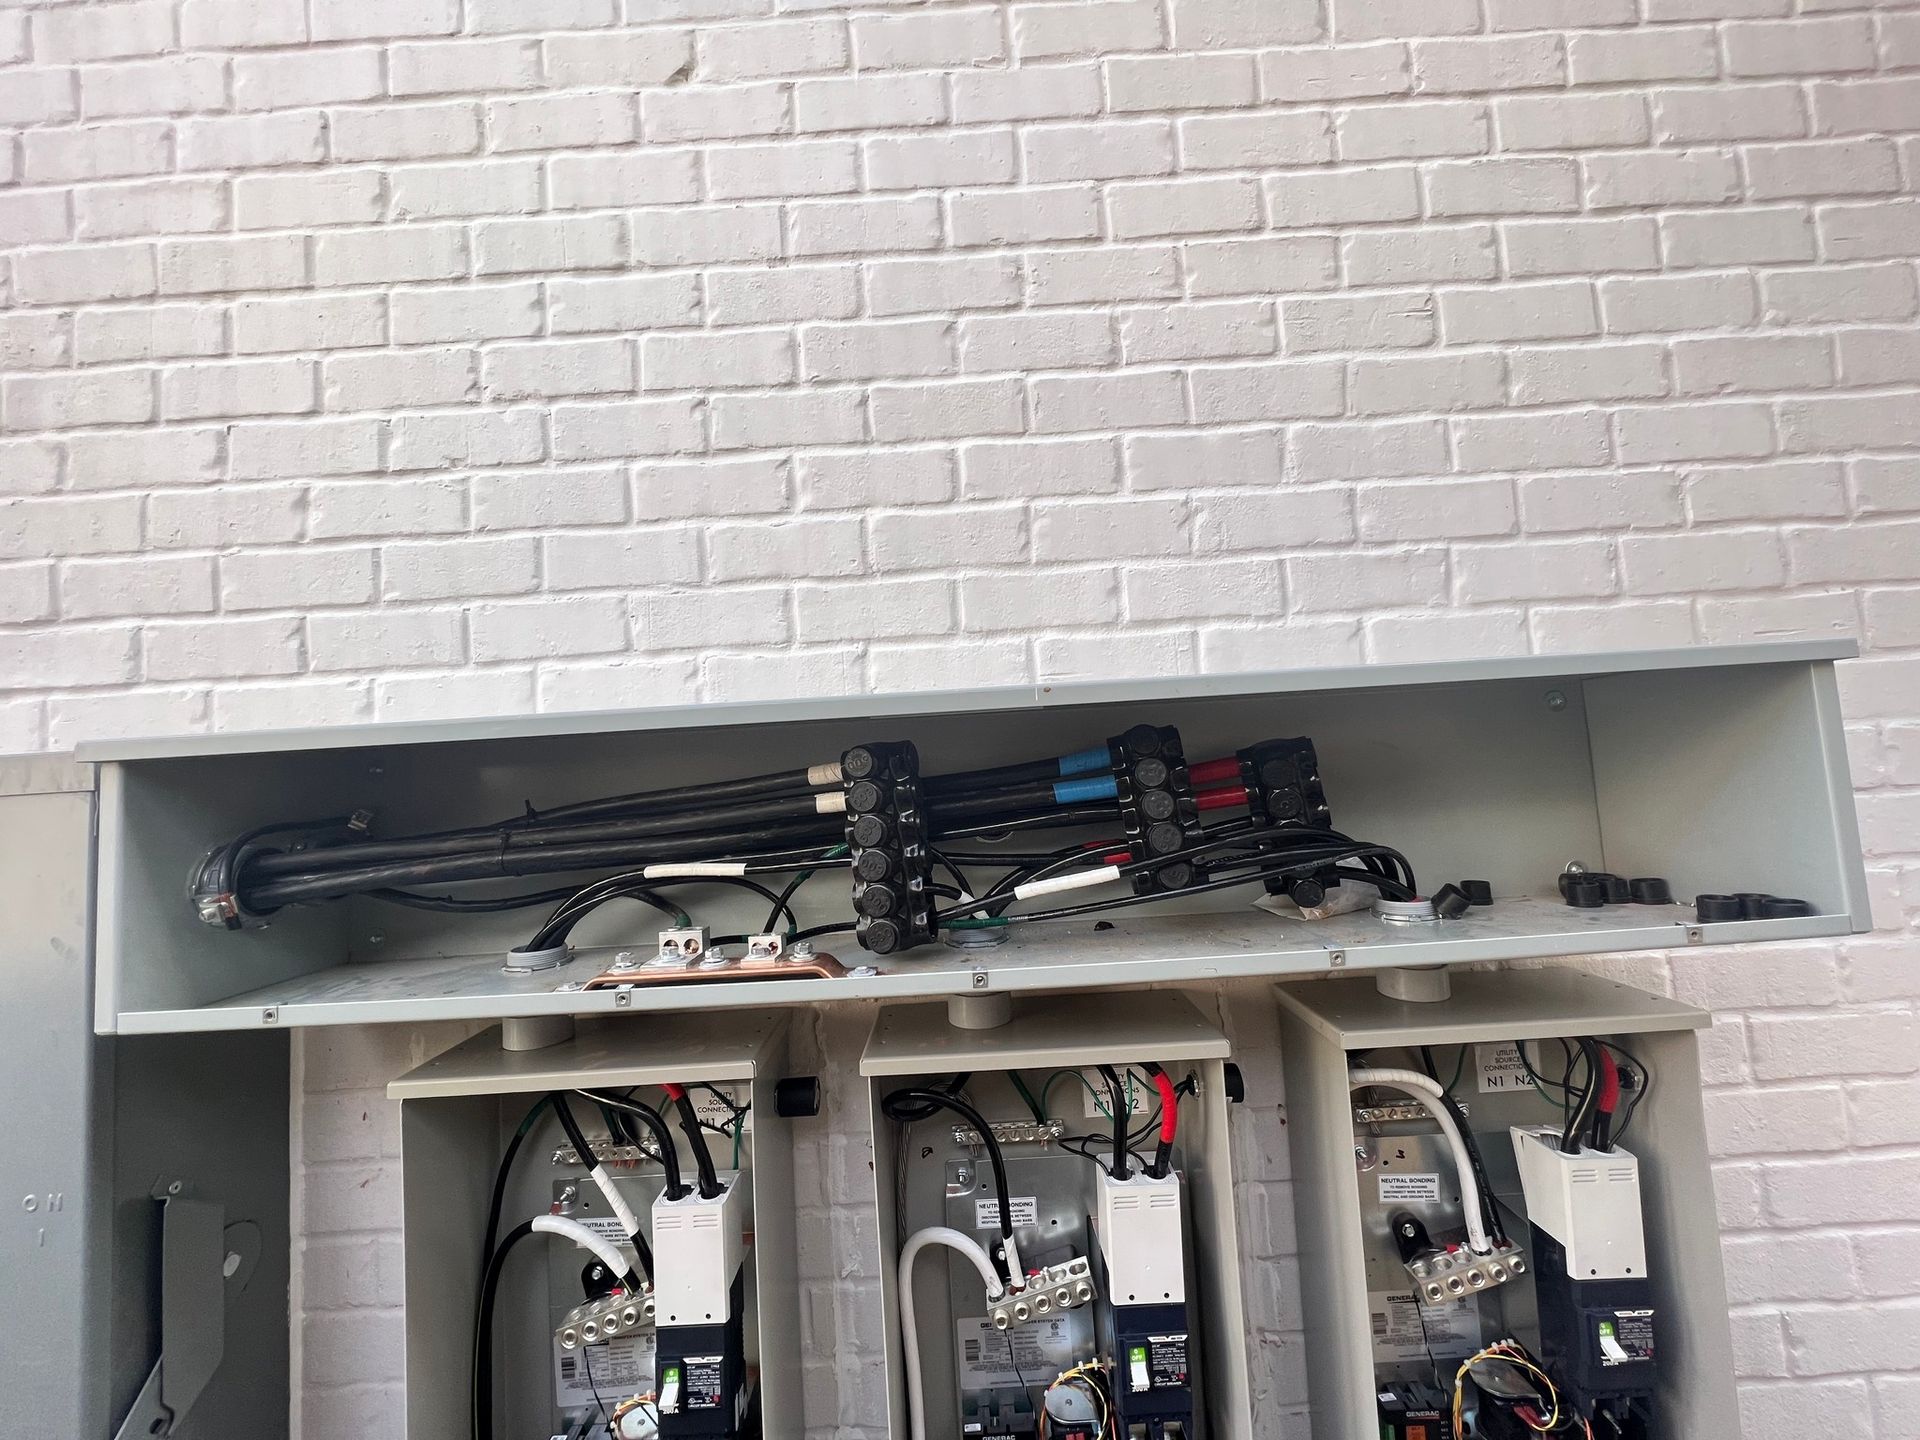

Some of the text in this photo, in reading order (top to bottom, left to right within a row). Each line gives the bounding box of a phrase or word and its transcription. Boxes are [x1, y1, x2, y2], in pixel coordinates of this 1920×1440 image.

[1484, 1063, 1524, 1072] CONNECTIO
[1487, 1075, 1504, 1088] N1
[1514, 1074, 1533, 1086] N2
[1405, 1410, 1440, 1418] GENERAC
